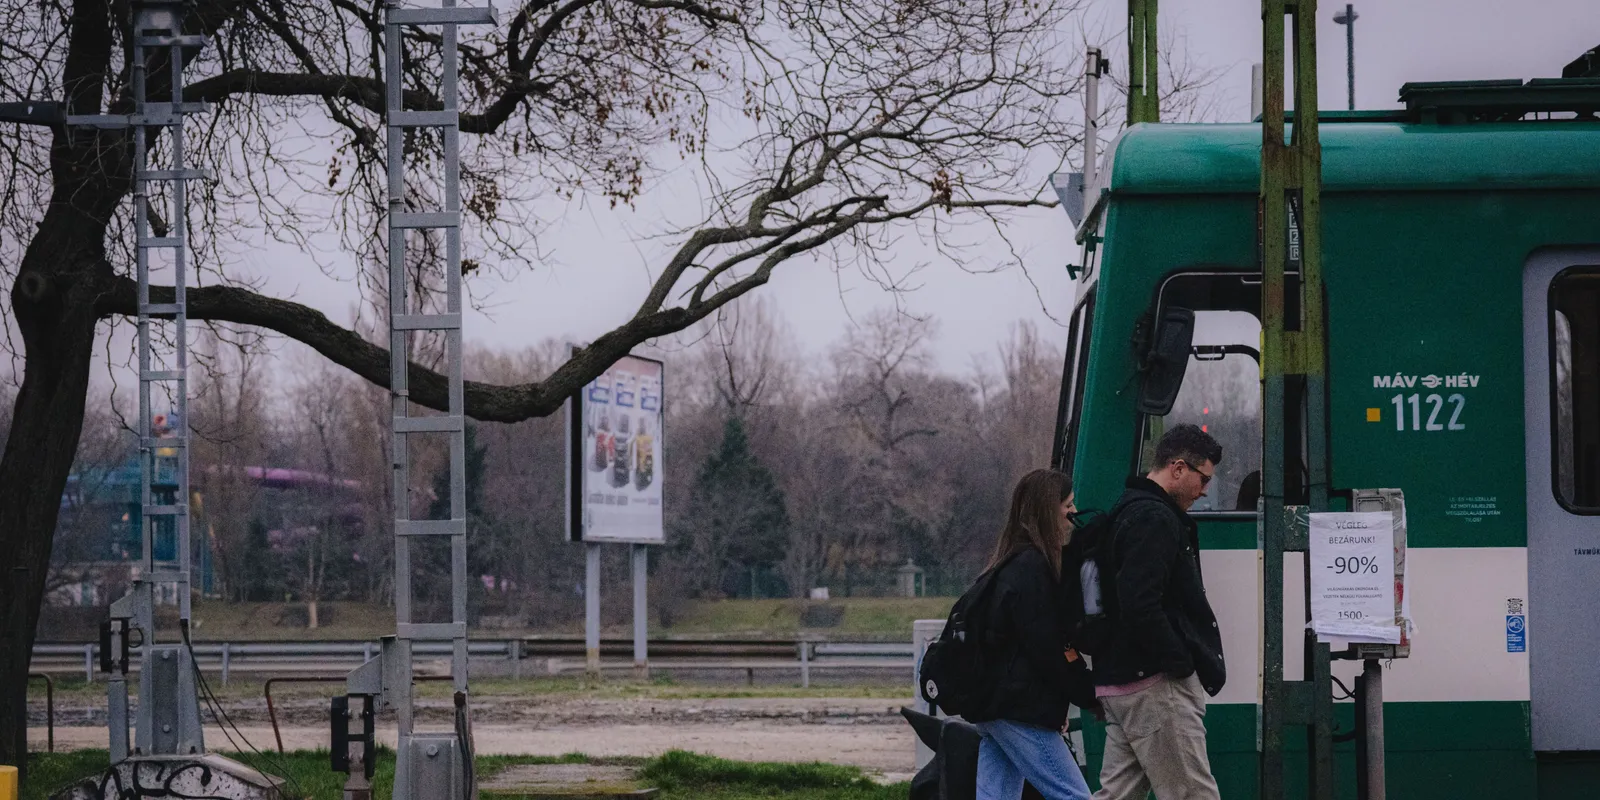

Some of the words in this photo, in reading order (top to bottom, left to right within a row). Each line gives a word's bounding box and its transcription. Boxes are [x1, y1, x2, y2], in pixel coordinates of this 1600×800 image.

[1373, 372, 1418, 388] MÁV
[1445, 372, 1480, 388] HÉV
[1391, 393, 1466, 431] 1122
[1335, 521, 1368, 529] VÉGLEG
[1328, 534, 1376, 545] BEZÁRUNK!
[1326, 556, 1379, 574] -90%
